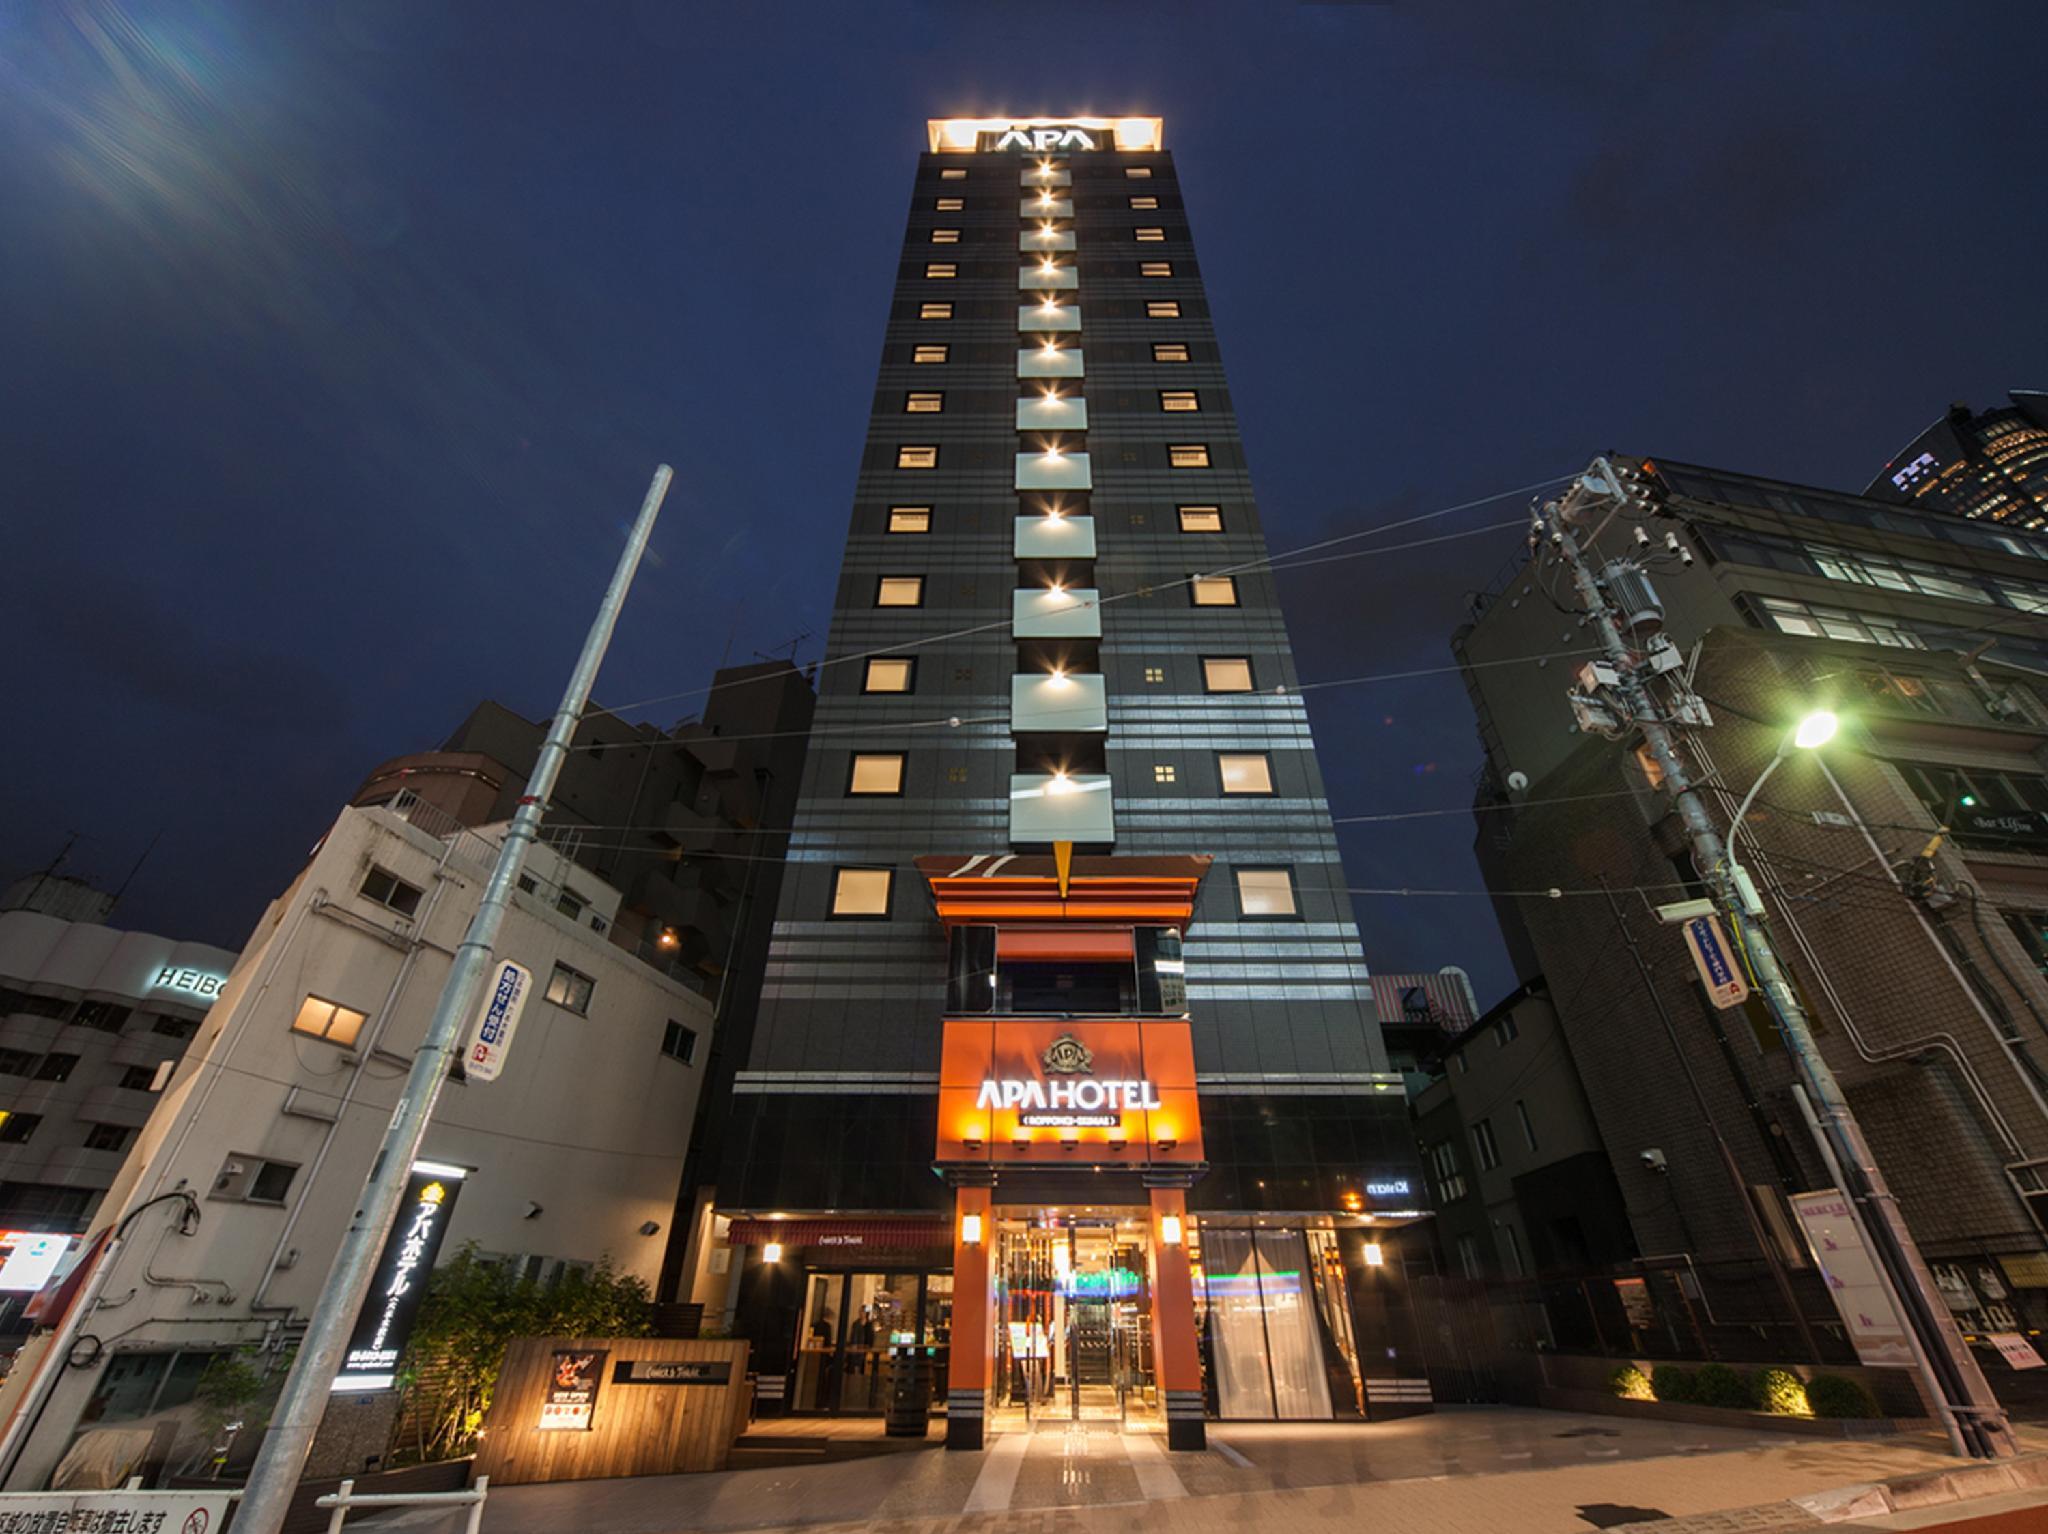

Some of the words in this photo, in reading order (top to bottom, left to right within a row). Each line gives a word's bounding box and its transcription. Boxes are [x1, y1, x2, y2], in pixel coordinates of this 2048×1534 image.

[996, 129, 1095, 151] APA
[976, 1080, 1047, 1110] APA
[1049, 1080, 1162, 1110] HOTEL
[386, 1202, 438, 1297] アパホテル
